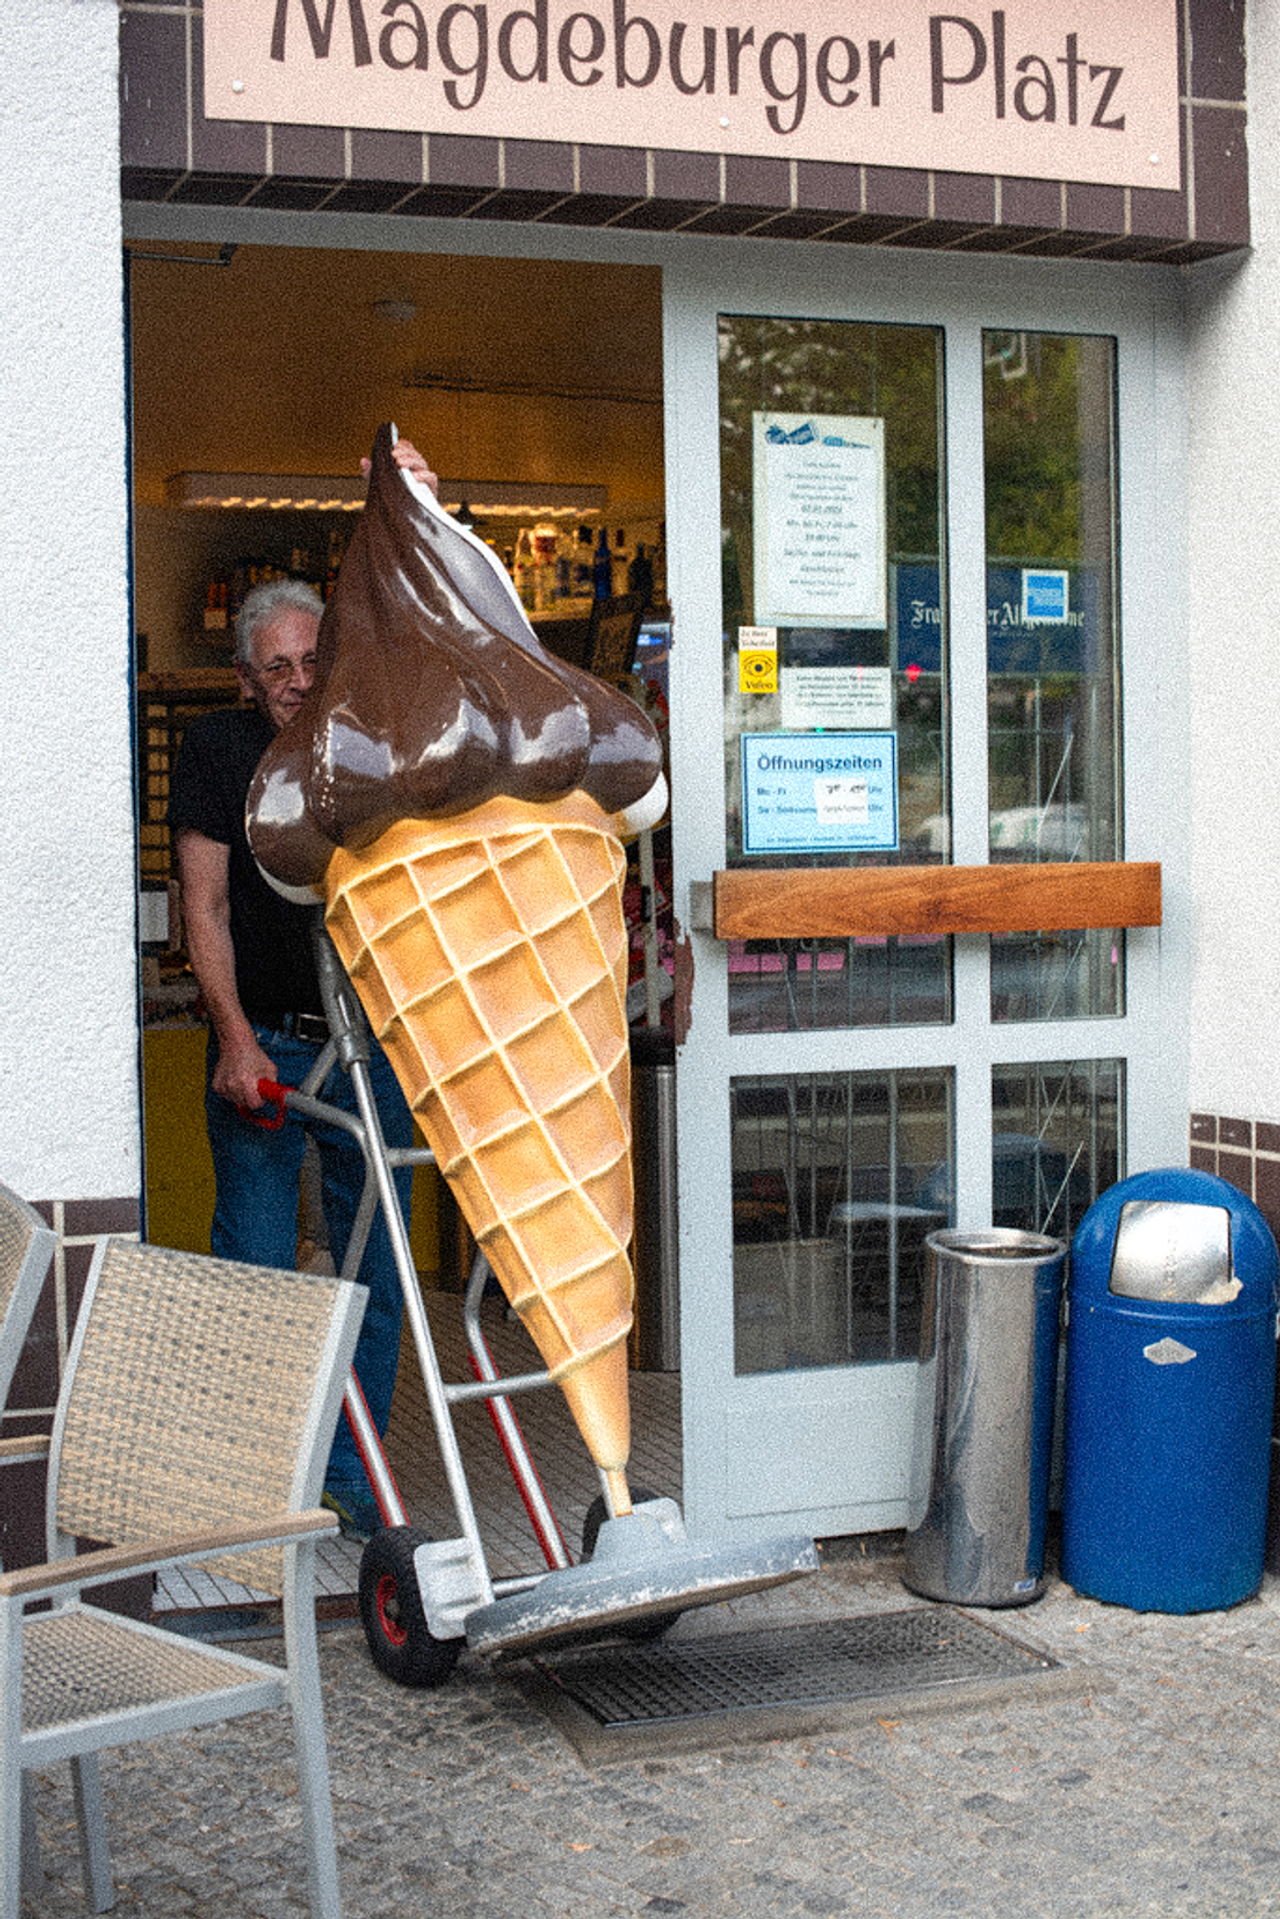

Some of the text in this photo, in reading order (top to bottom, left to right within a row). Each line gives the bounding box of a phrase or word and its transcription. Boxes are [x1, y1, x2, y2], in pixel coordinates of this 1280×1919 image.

[269, 0, 1127, 135] Magdeburger Platz
[745, 679, 774, 689] Video
[757, 751, 883, 773] Öffnungszeiten
